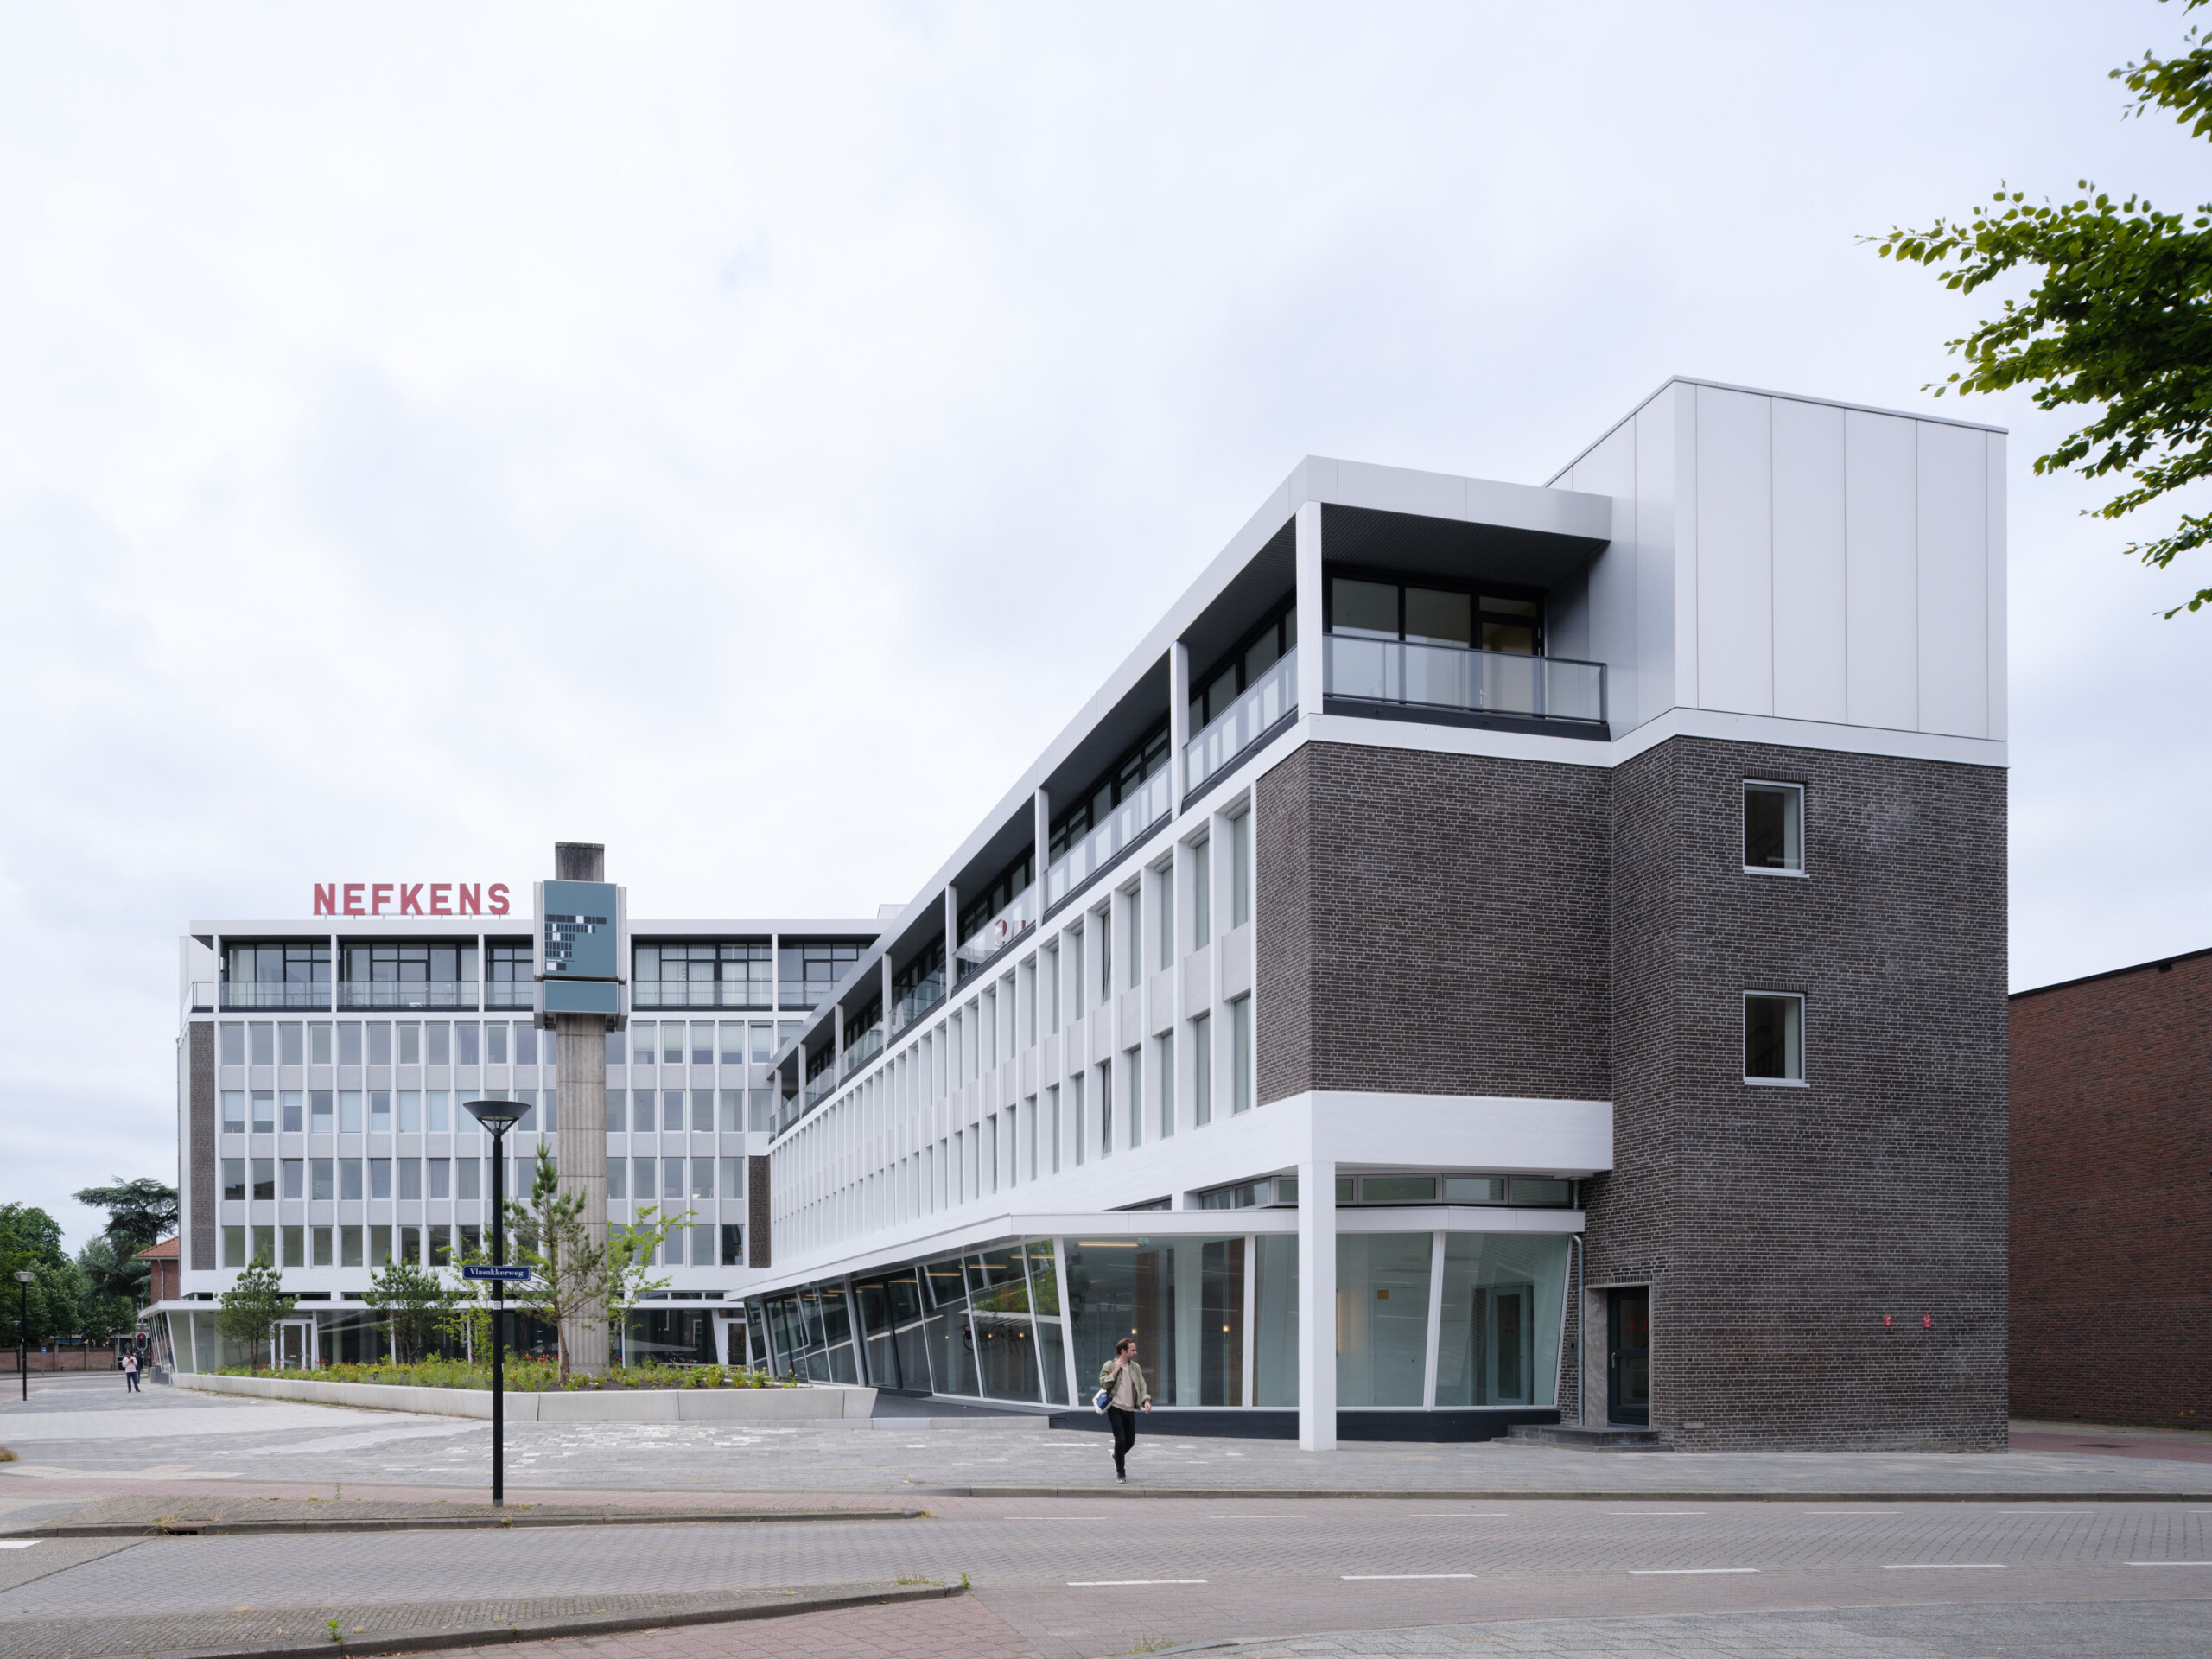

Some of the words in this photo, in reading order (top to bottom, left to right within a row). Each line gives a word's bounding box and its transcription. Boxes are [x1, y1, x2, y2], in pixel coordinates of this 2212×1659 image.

[314, 883, 510, 915] NEFKENS
[469, 1268, 524, 1278] Vlasakkerweg
[1627, 1319, 1647, 1332] 23
